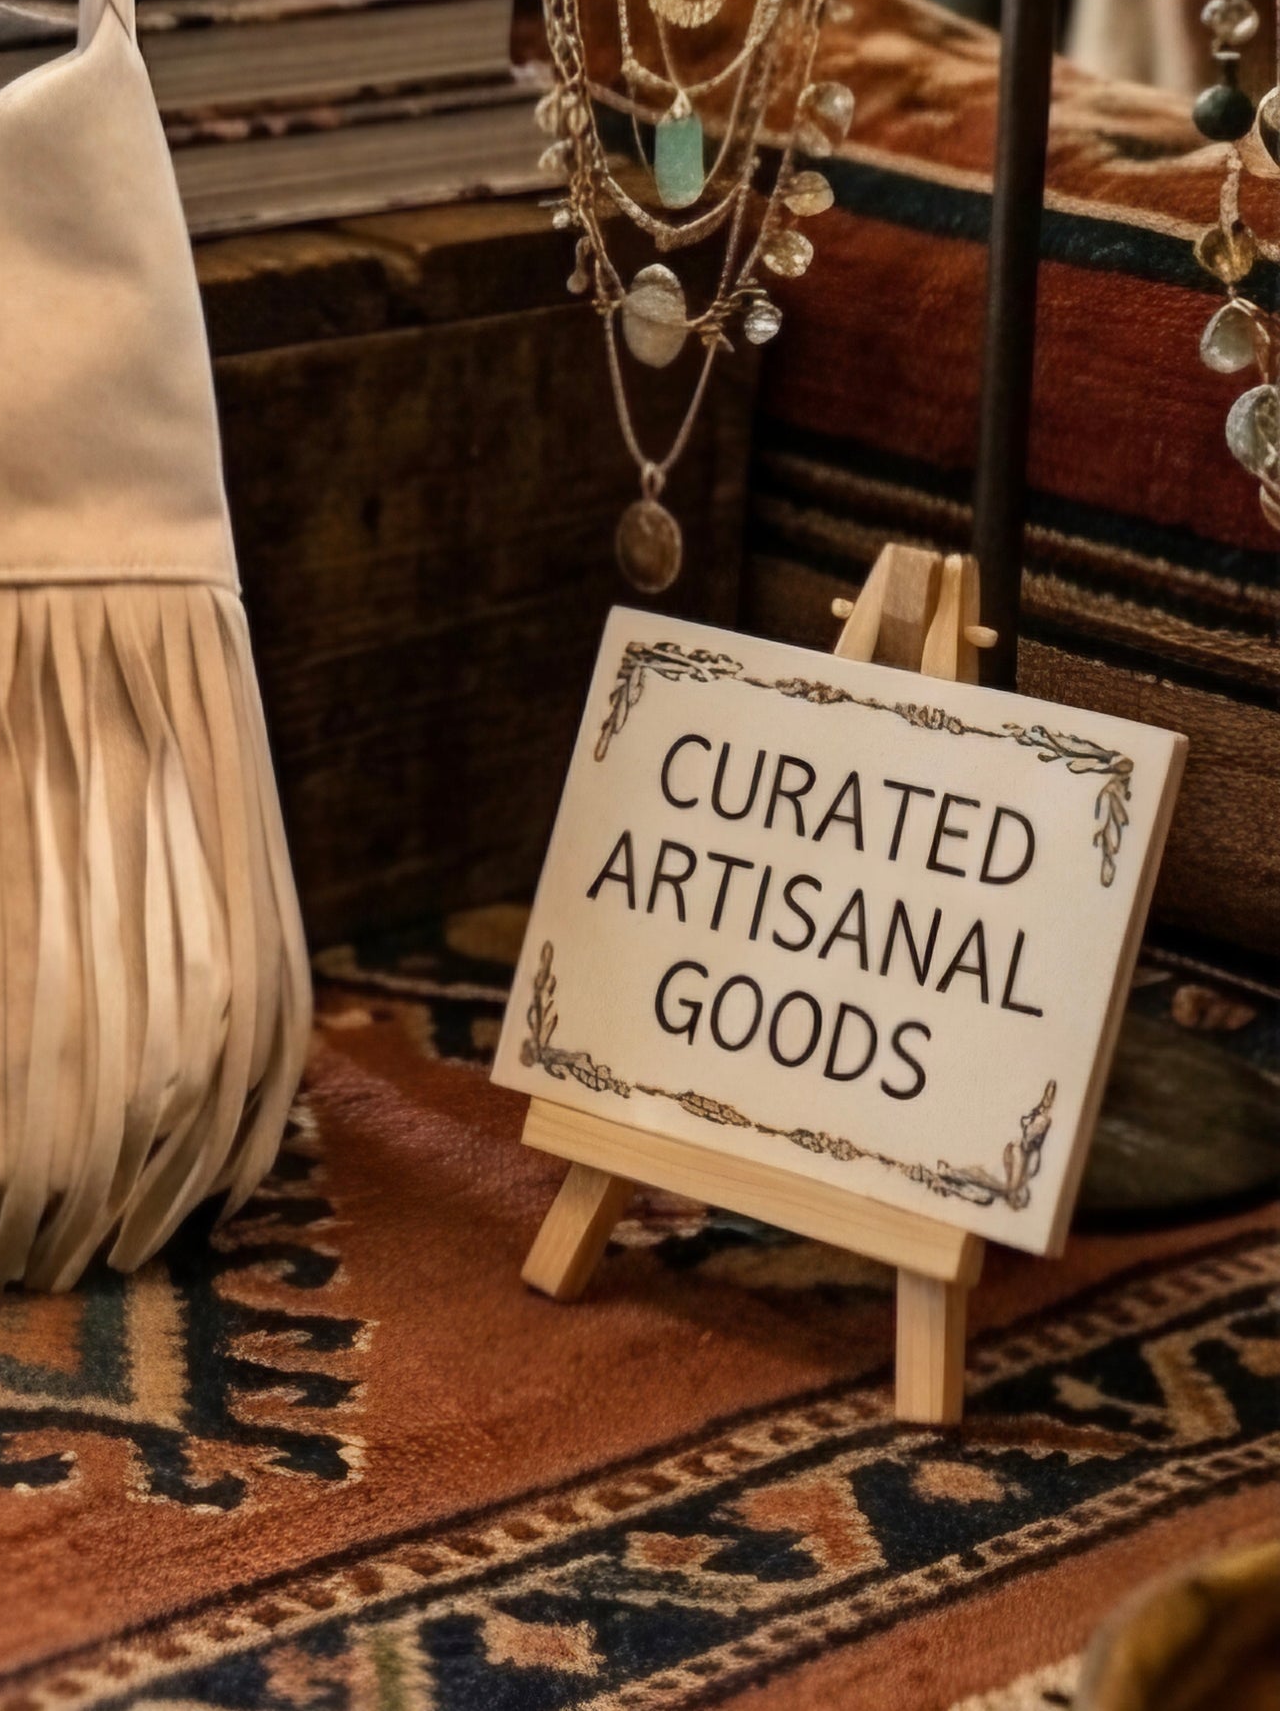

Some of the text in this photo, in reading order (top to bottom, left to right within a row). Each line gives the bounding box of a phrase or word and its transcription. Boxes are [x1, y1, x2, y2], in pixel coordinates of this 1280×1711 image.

[660, 734, 1036, 885] CURATED
[586, 830, 1043, 1018] ARTISANAL
[654, 960, 932, 1100] GOODS
